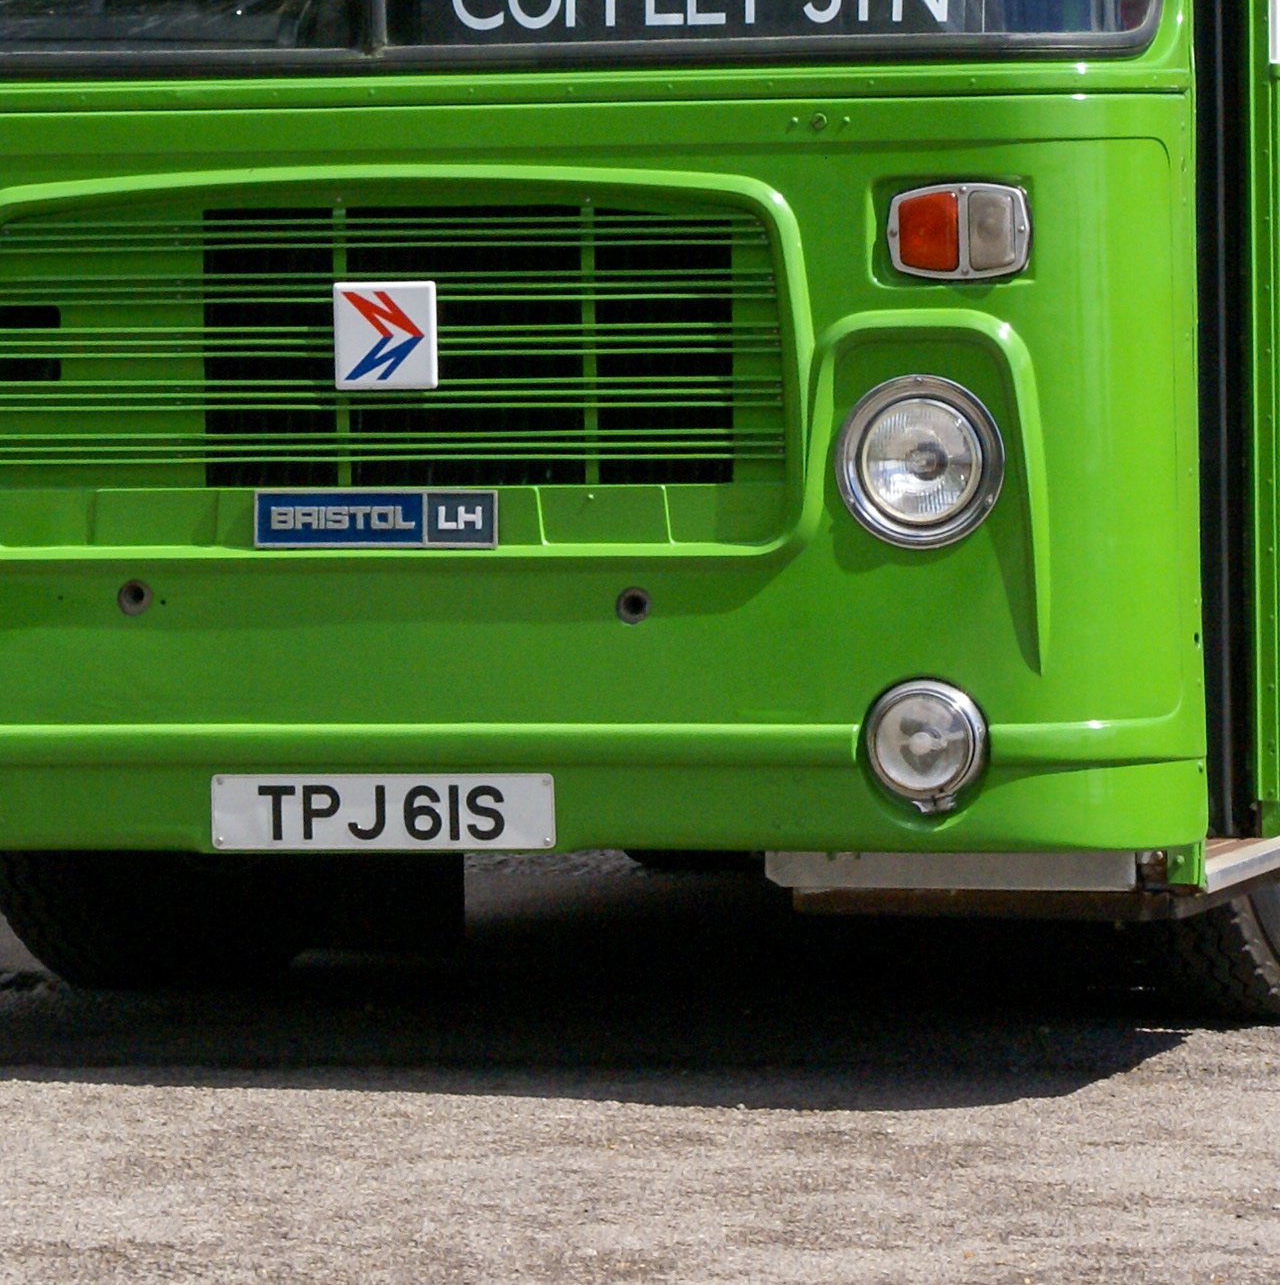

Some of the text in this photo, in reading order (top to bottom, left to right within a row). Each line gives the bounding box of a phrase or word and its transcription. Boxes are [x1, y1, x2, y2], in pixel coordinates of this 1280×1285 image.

[270, 505, 483, 531] BRISTOL LH
[258, 784, 386, 841] TPJ
